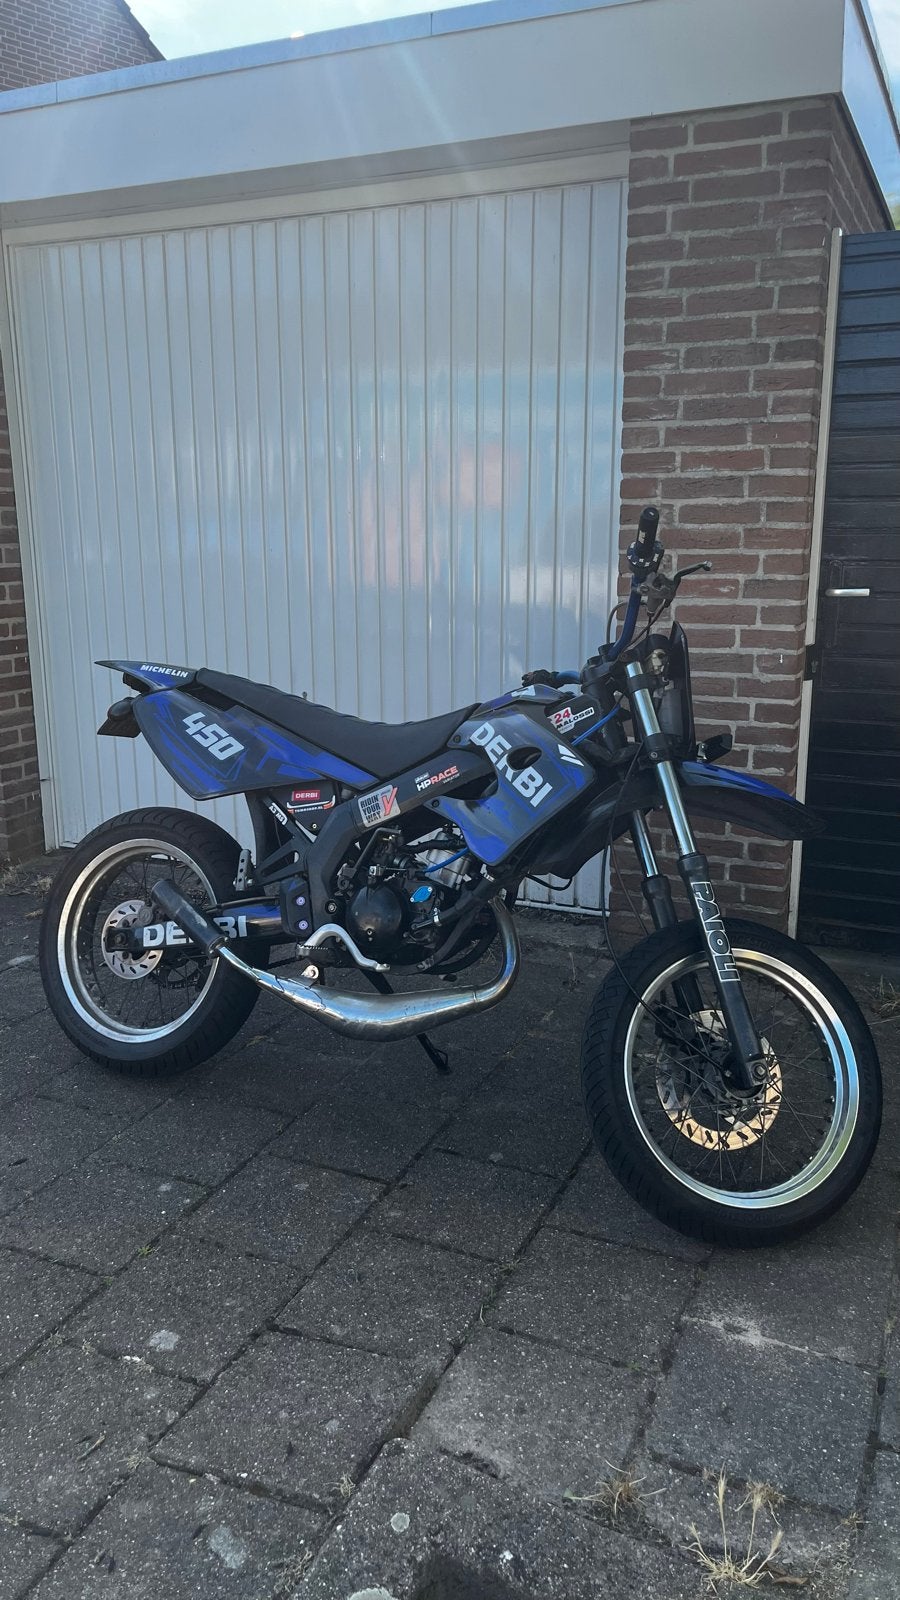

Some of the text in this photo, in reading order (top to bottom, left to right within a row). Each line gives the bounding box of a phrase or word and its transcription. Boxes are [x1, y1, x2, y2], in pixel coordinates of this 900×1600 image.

[141, 664, 188, 678] MICHELIN
[554, 709, 571, 724] 24
[557, 708, 593, 729] MALOSSI
[182, 711, 245, 761] 450
[362, 803, 381, 815] YOUR
[366, 810, 381, 823] WAY
[142, 915, 248, 947] DEBI
[691, 881, 741, 983] PAIOLI
